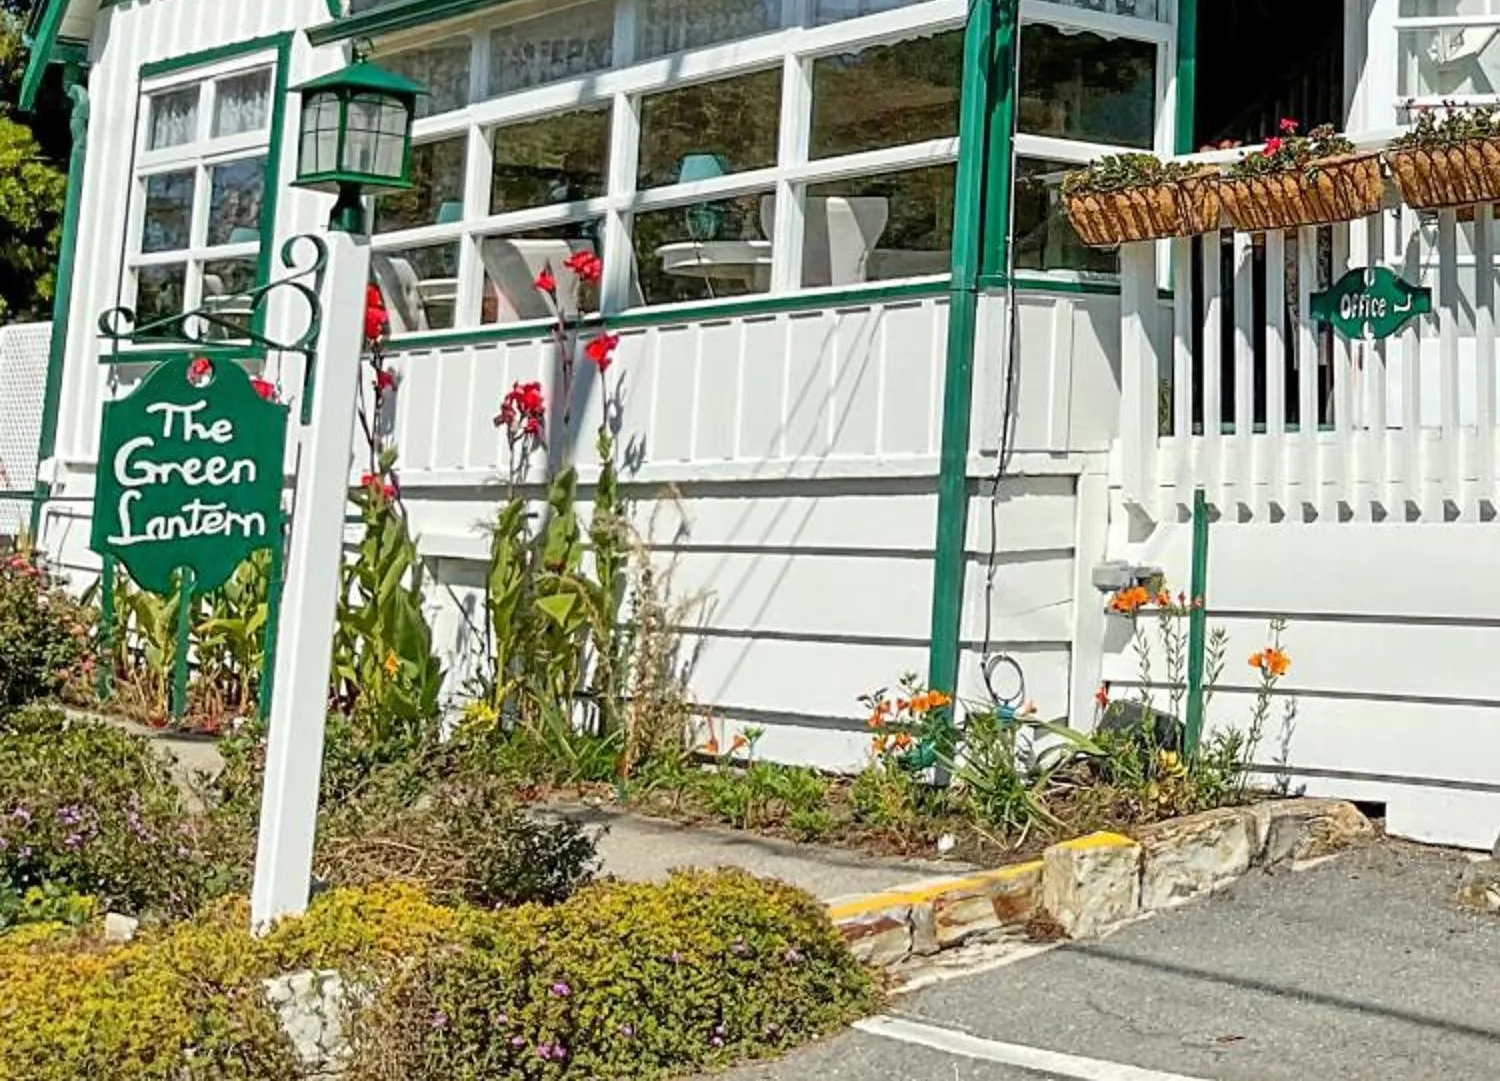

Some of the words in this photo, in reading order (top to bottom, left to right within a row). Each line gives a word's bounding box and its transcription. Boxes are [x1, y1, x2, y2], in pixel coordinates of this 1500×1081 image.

[1340, 292, 1387, 320] Office
[146, 400, 233, 442] The
[114, 436, 257, 486] Green
[107, 489, 265, 546] Lantern
